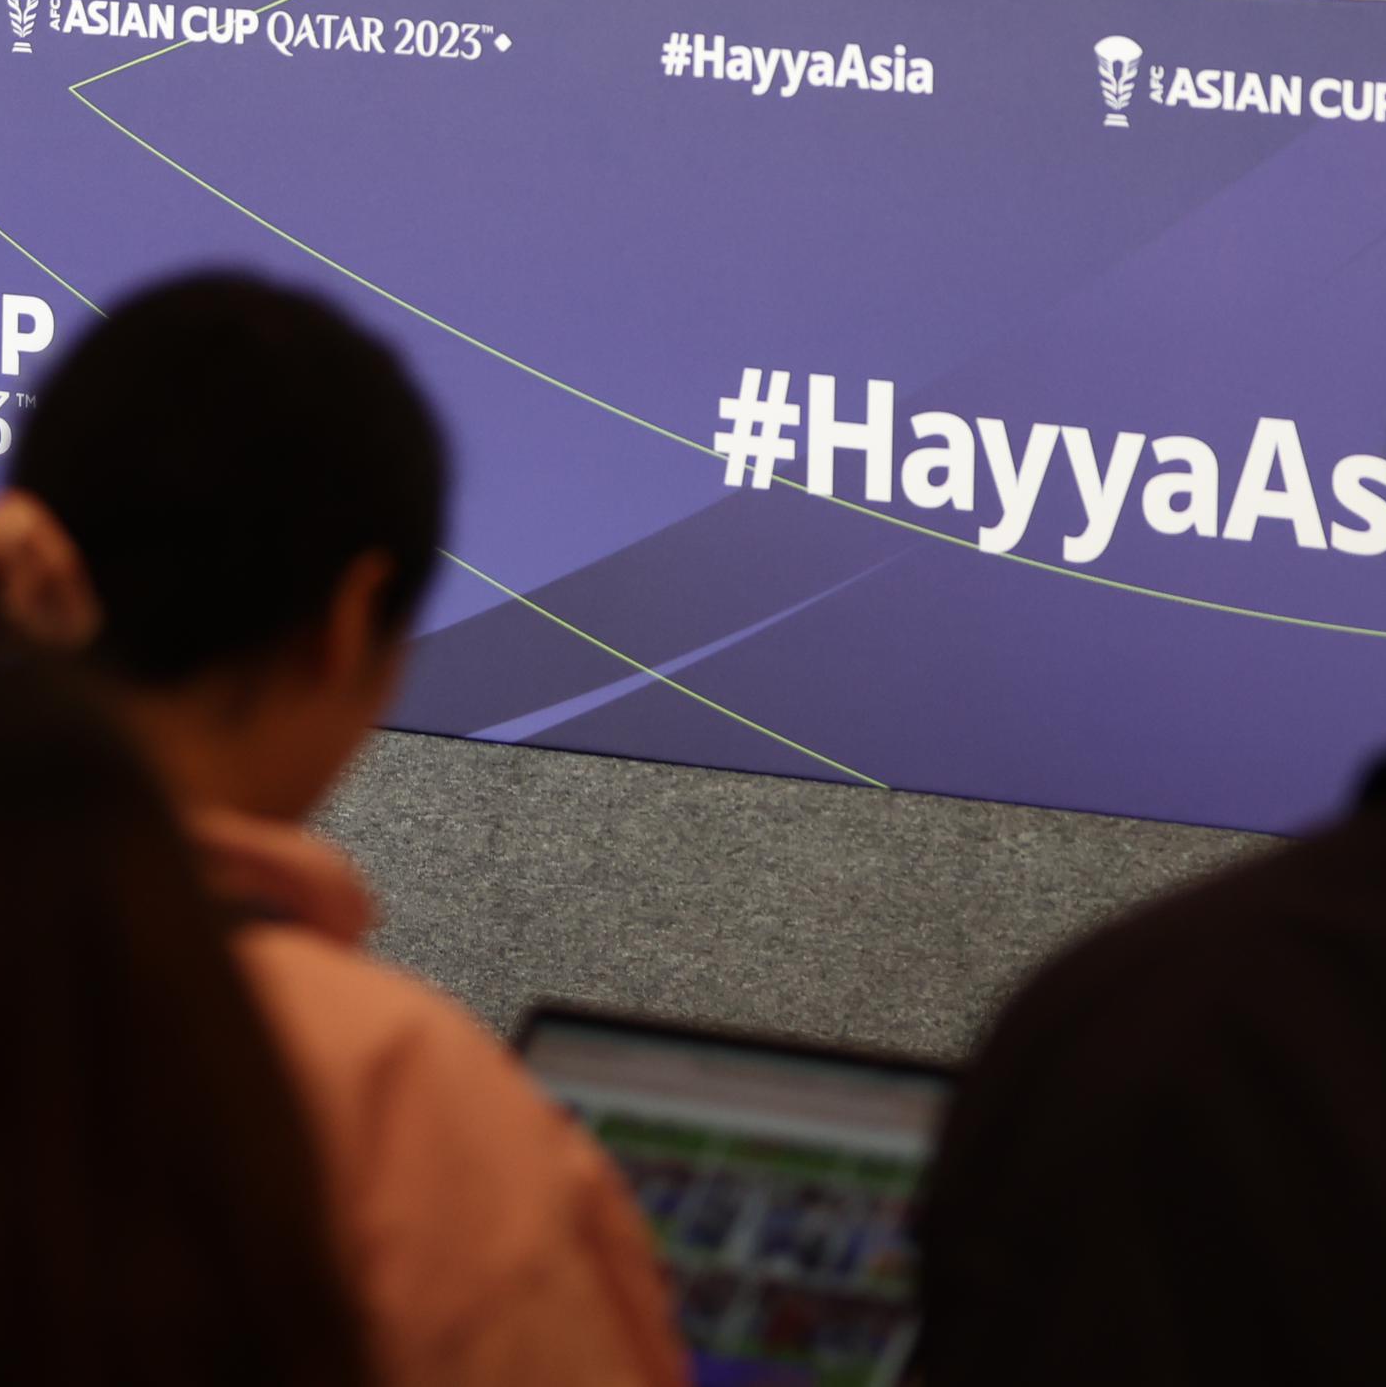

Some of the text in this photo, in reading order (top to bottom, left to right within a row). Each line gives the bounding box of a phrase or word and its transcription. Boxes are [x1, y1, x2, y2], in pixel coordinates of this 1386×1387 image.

[63, 0, 174, 39] ASIAN
[180, 5, 259, 45] CUP
[267, 11, 385, 56] QATAR
[661, 33, 933, 97] #HayyaAsia
[1150, 66, 1164, 103] AFC
[1166, 68, 1302, 115] ASIAN
